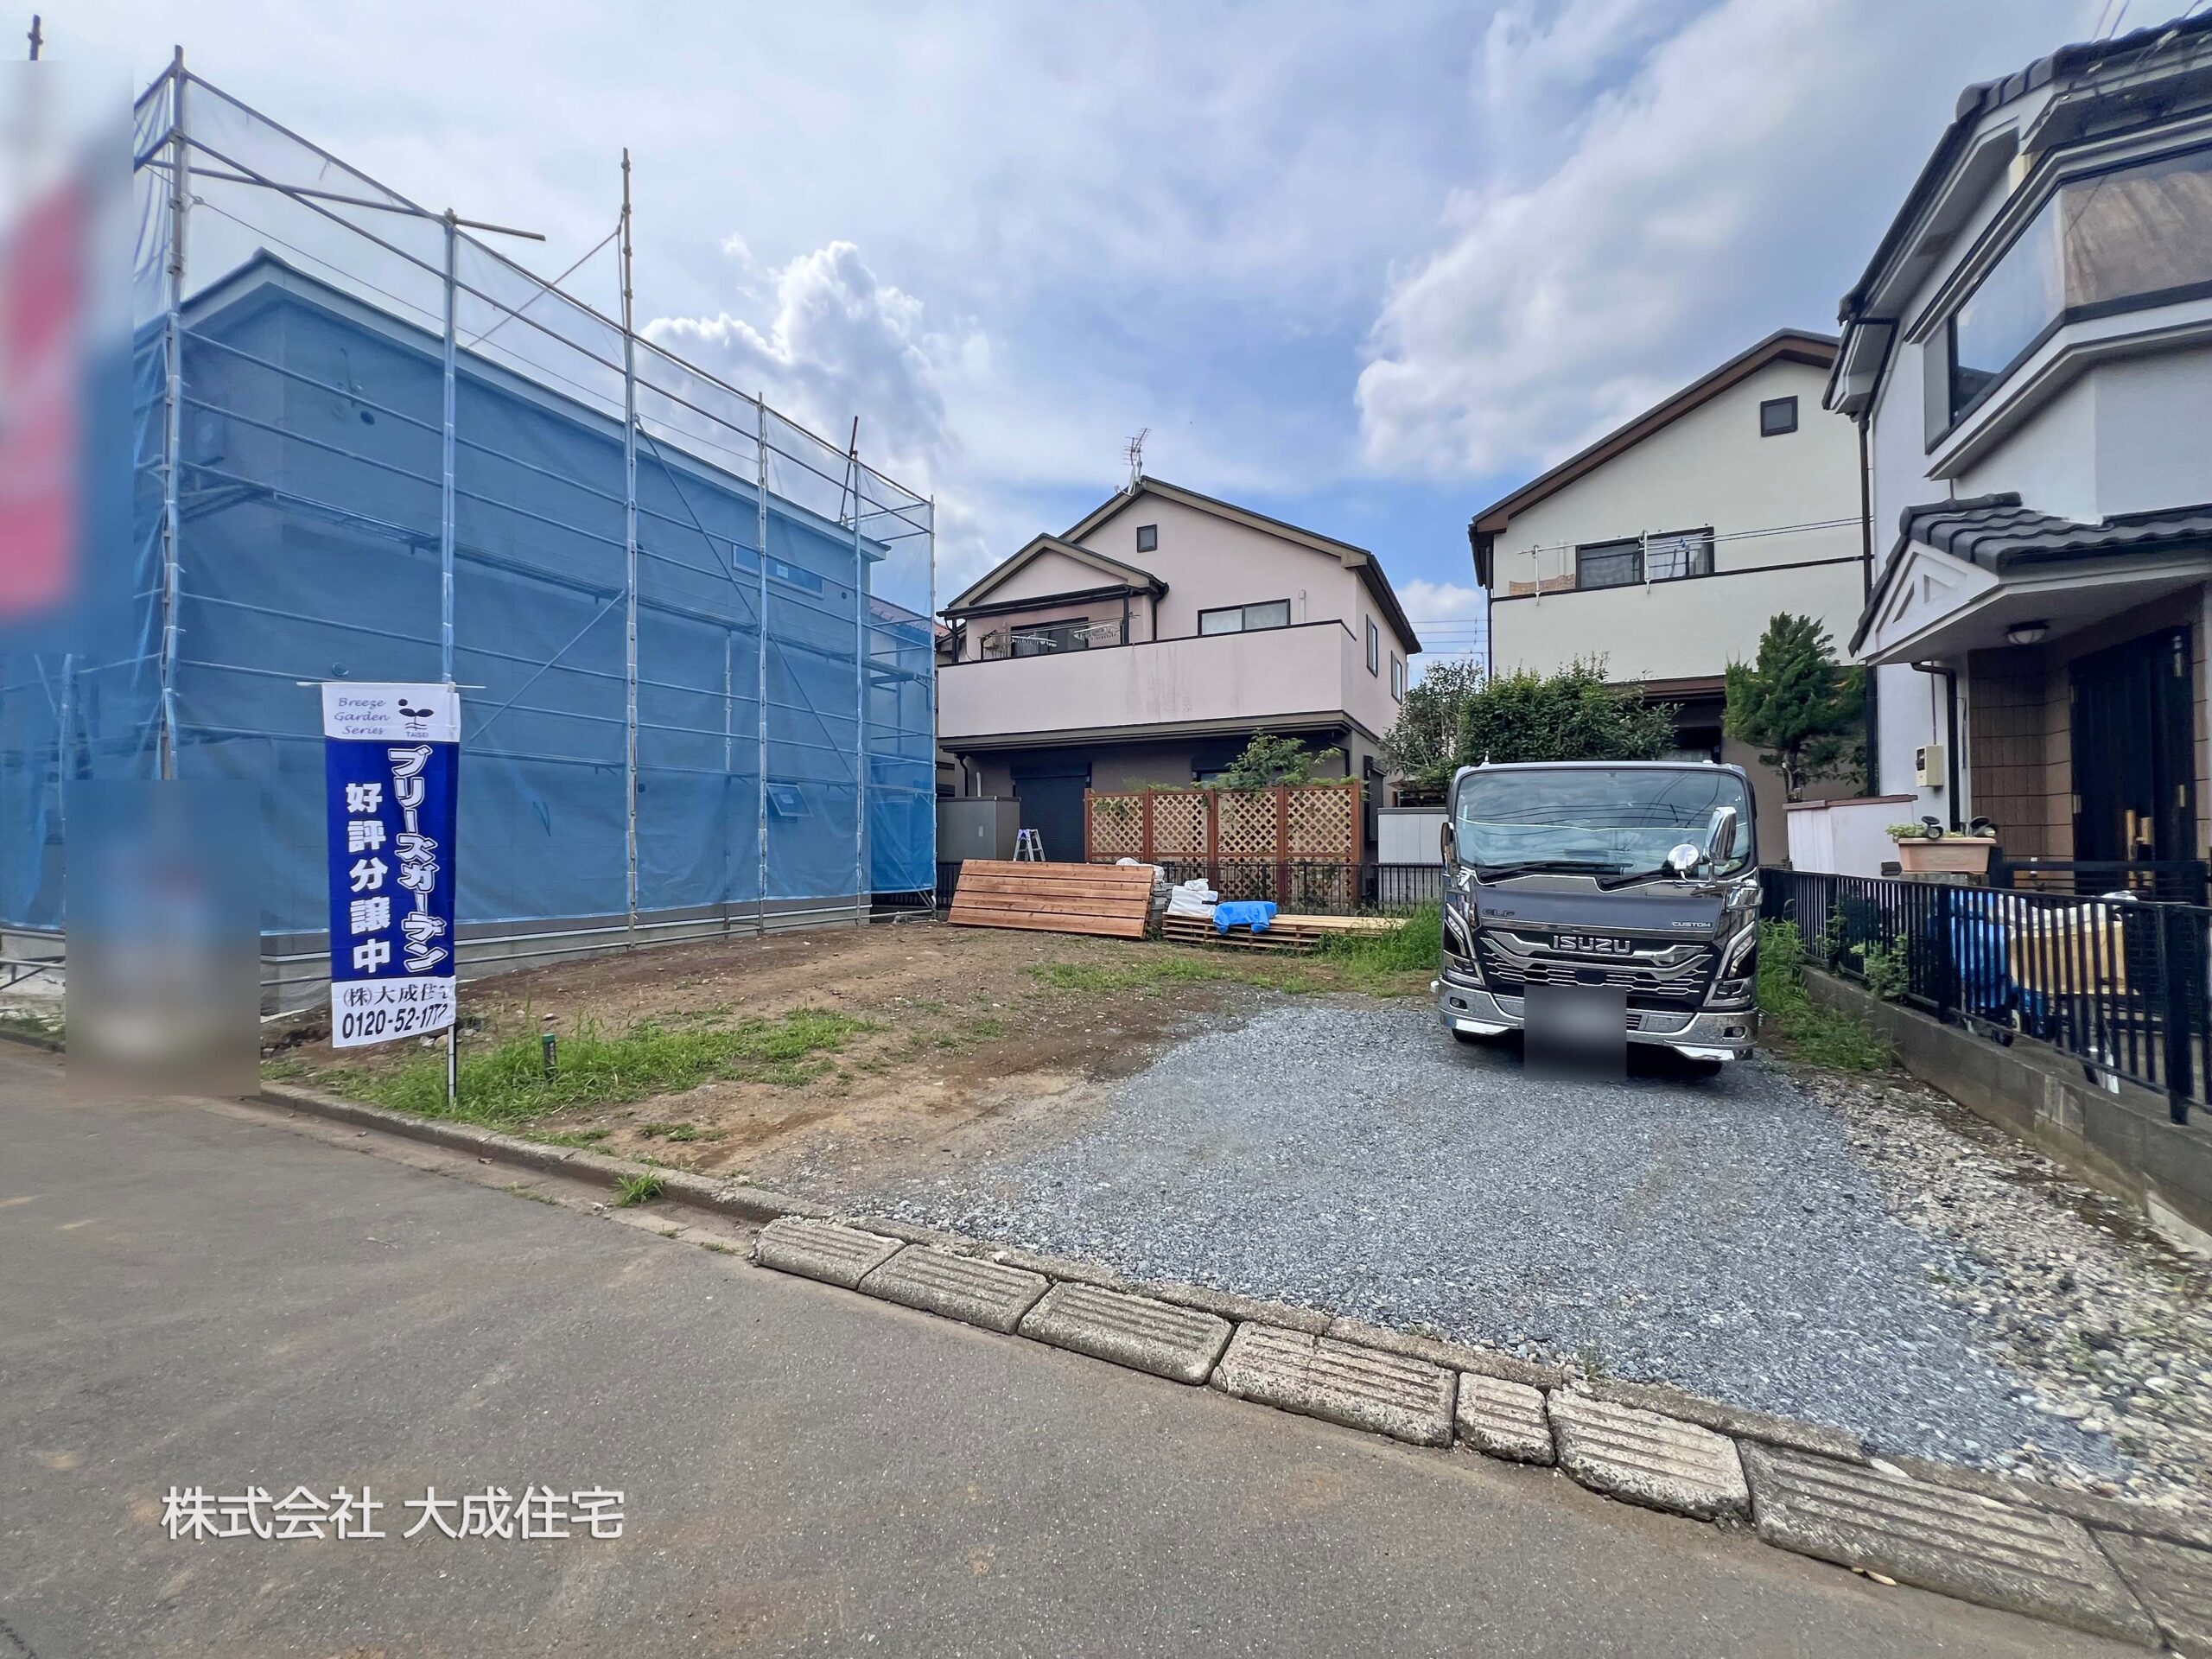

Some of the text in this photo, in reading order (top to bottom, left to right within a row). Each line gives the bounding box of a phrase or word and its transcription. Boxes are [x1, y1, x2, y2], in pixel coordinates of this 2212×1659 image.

[338, 697, 386, 709] Breeze
[334, 711, 391, 722] Garden
[342, 725, 385, 735] Series
[388, 744, 448, 973] ブリーズガーデン
[346, 782, 391, 974] 好評分譲中
[1553, 935, 1630, 953] ISUZU
